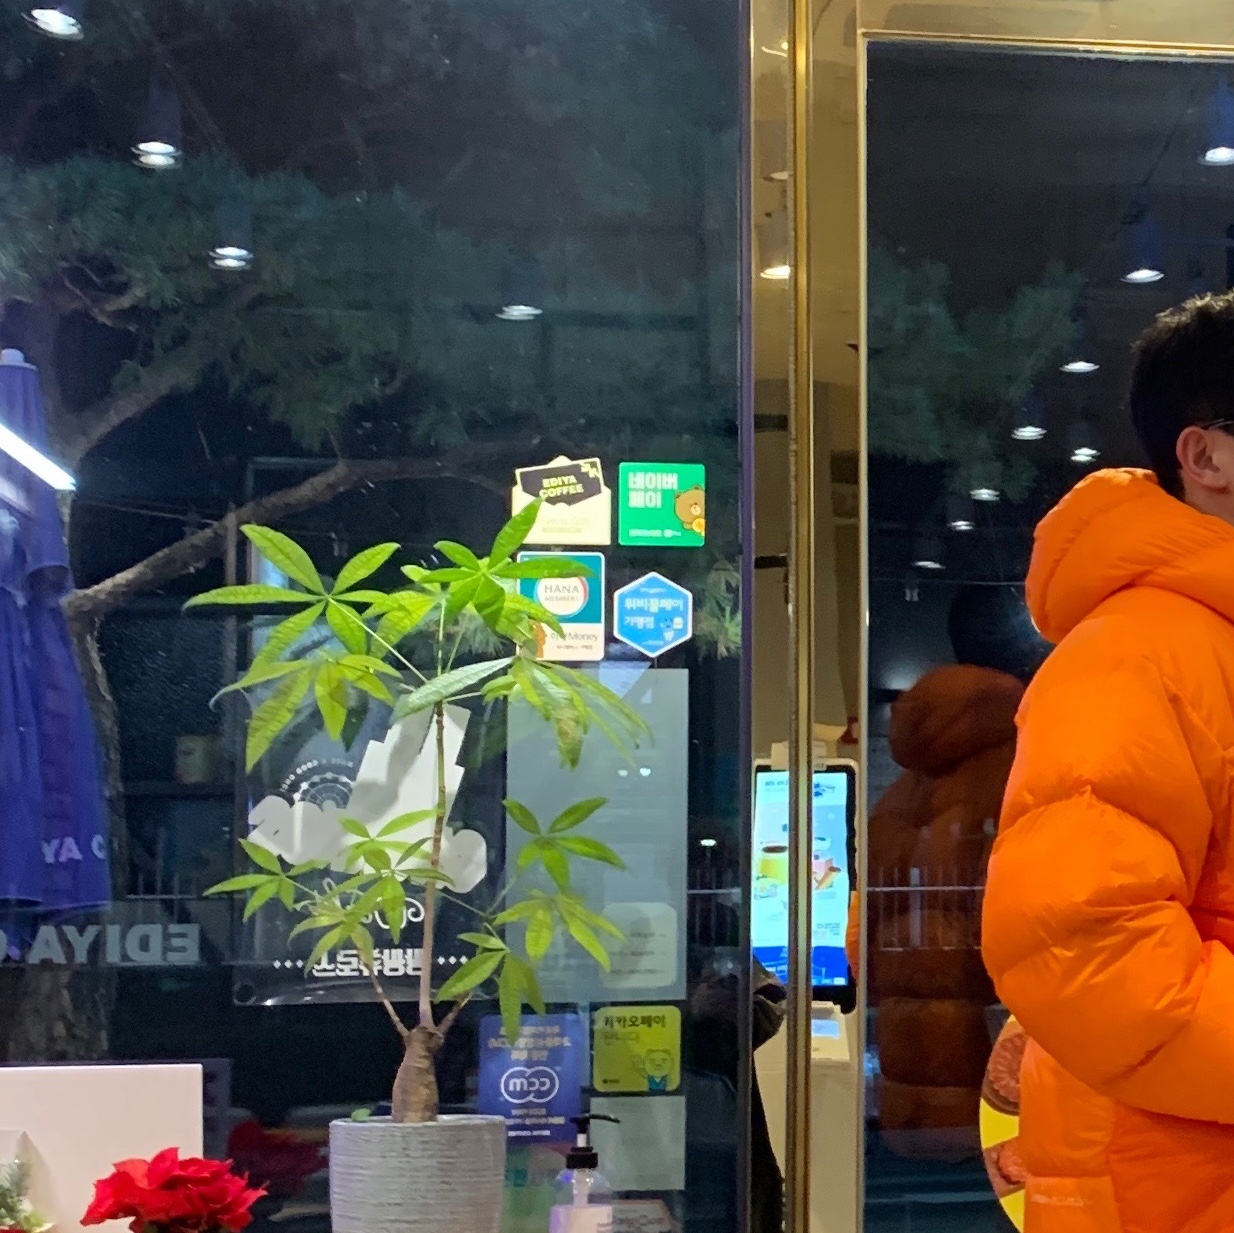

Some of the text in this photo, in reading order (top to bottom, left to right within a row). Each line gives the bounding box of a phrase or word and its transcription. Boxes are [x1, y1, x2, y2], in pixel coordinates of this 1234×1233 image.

[542, 474, 577, 488] EDIYA
[539, 484, 585, 498] COFFEE
[544, 584, 580, 594] HANA
